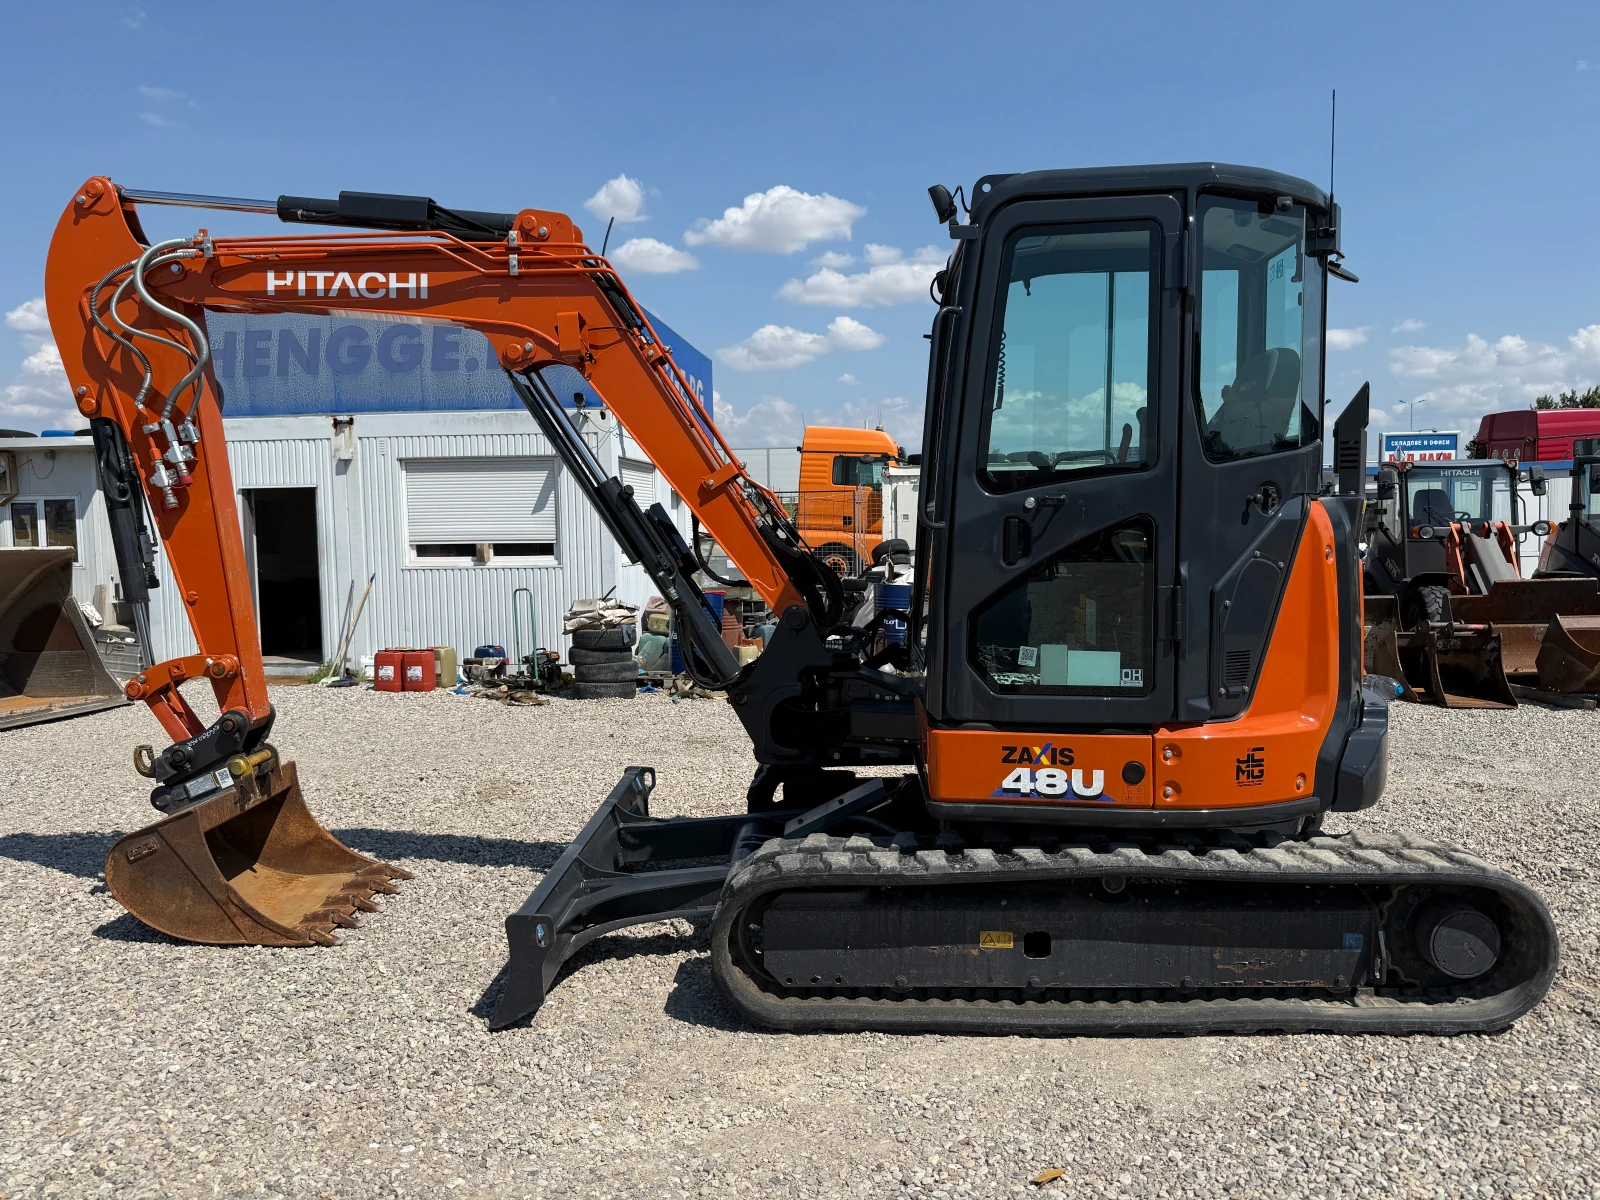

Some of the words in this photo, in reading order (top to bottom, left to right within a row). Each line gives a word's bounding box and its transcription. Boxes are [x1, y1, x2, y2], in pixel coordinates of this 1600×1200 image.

[266, 269, 429, 300] HITACHI
[1389, 454, 1415, 462] ПД
[1440, 469, 1480, 477] HITACHI
[1001, 743, 1075, 766] ZAXIS
[1001, 767, 1105, 799] 48U
